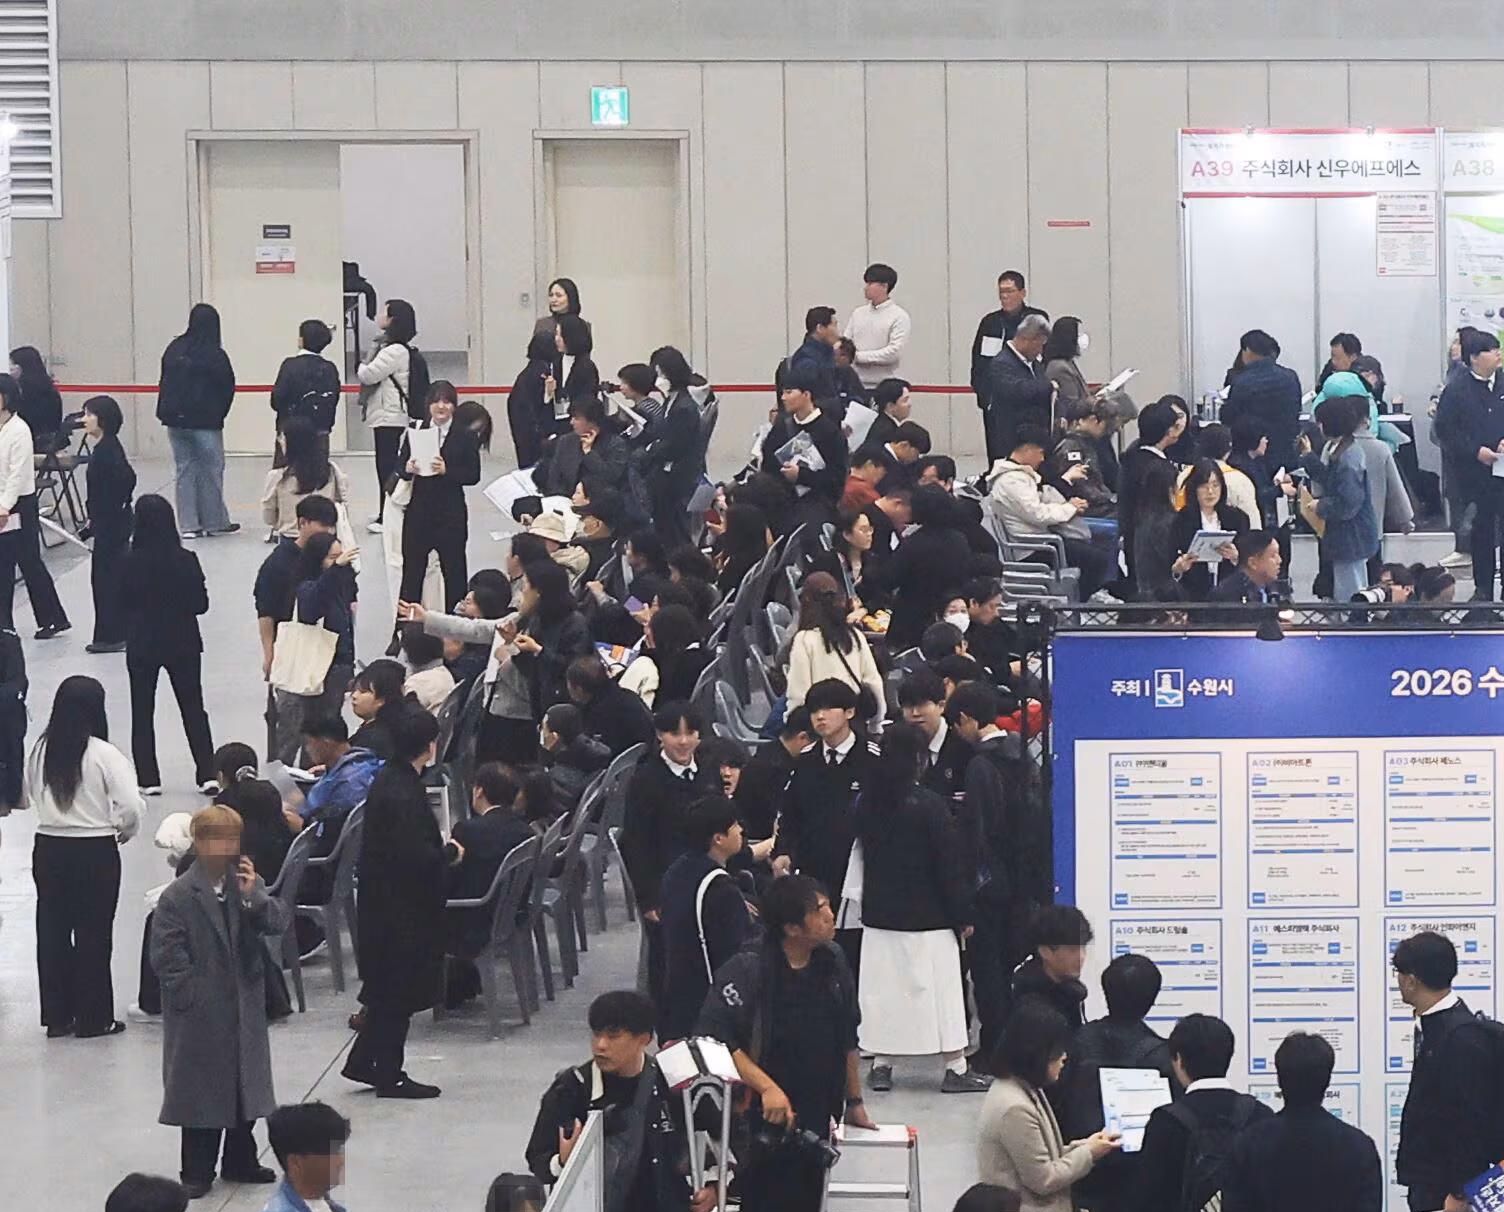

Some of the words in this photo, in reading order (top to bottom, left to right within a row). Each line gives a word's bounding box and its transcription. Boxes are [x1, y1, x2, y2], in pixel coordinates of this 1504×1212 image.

[1190, 159, 1235, 179] A39
[1241, 157, 1312, 180] 주식회사
[1316, 157, 1422, 180] 신우에프에스
[1452, 159, 1496, 178] A38
[1110, 679, 1141, 698] 주최
[1186, 676, 1234, 697] 수원시
[1390, 668, 1473, 697] 2026
